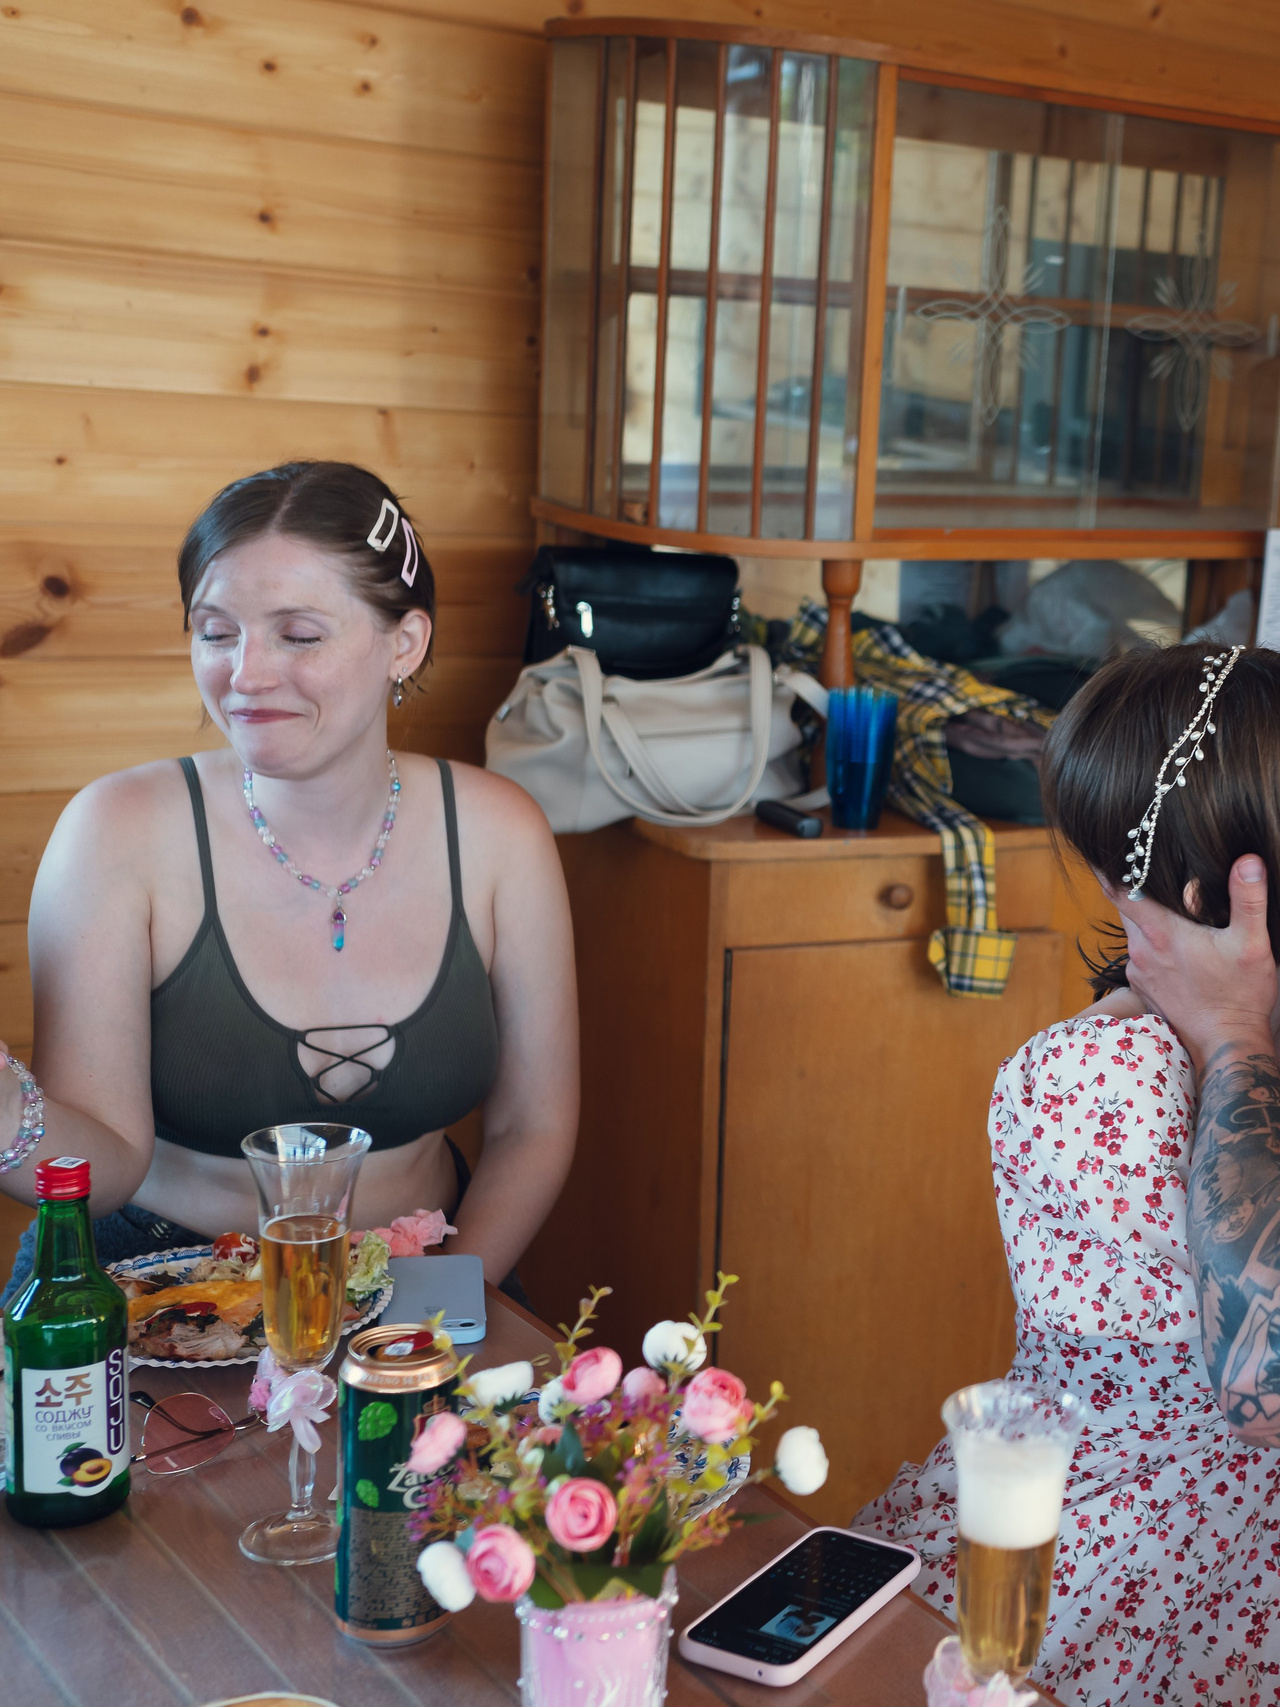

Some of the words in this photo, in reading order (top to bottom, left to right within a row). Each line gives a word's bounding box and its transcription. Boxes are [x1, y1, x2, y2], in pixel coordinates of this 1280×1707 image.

[34, 1372, 93, 1408] 소주
[108, 1348, 124, 1451] SOJU
[35, 1407, 92, 1424] СОДЖУ
